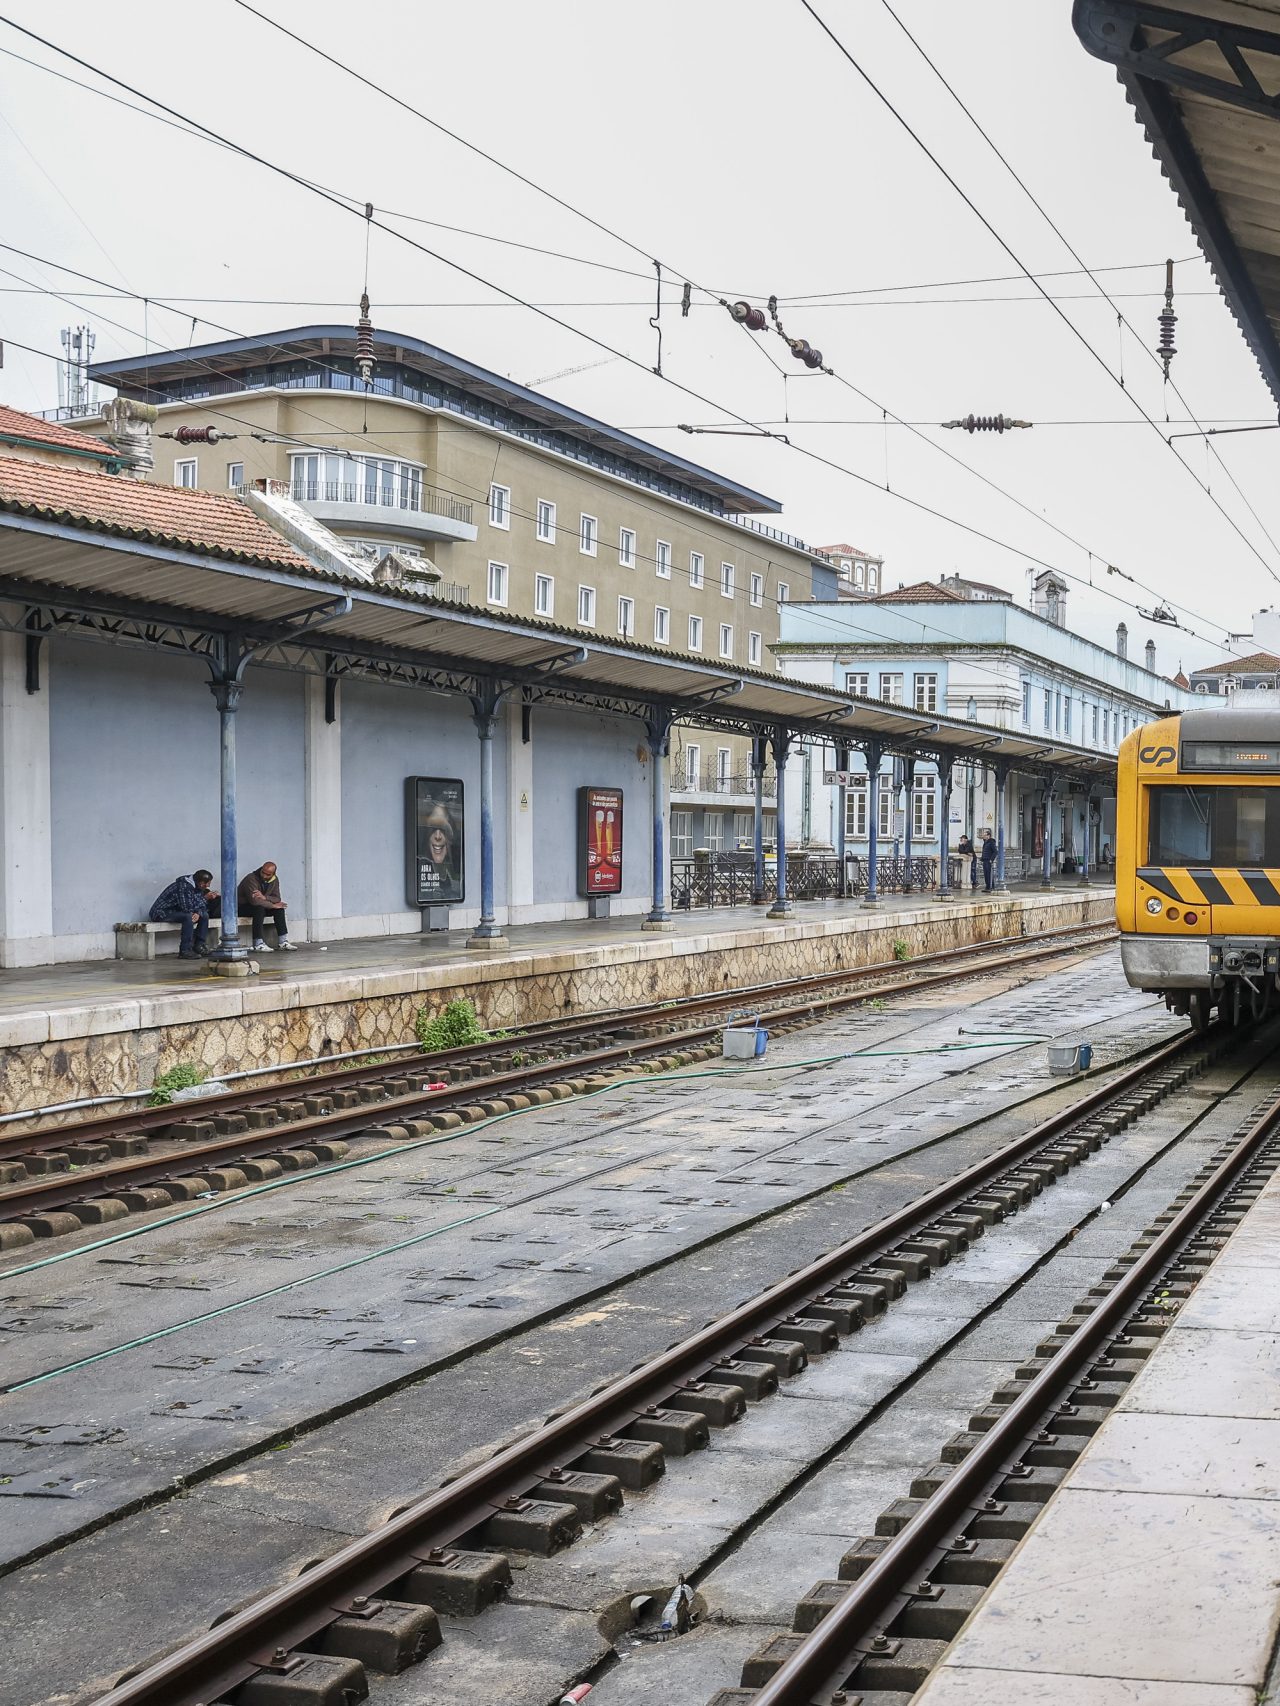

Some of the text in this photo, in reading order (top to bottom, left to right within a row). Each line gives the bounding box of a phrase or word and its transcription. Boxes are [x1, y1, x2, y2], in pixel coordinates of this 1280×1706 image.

[1140, 747, 1176, 767] CP
[421, 864, 432, 873] ABRA
[420, 872, 440, 881] OS OLHOS
